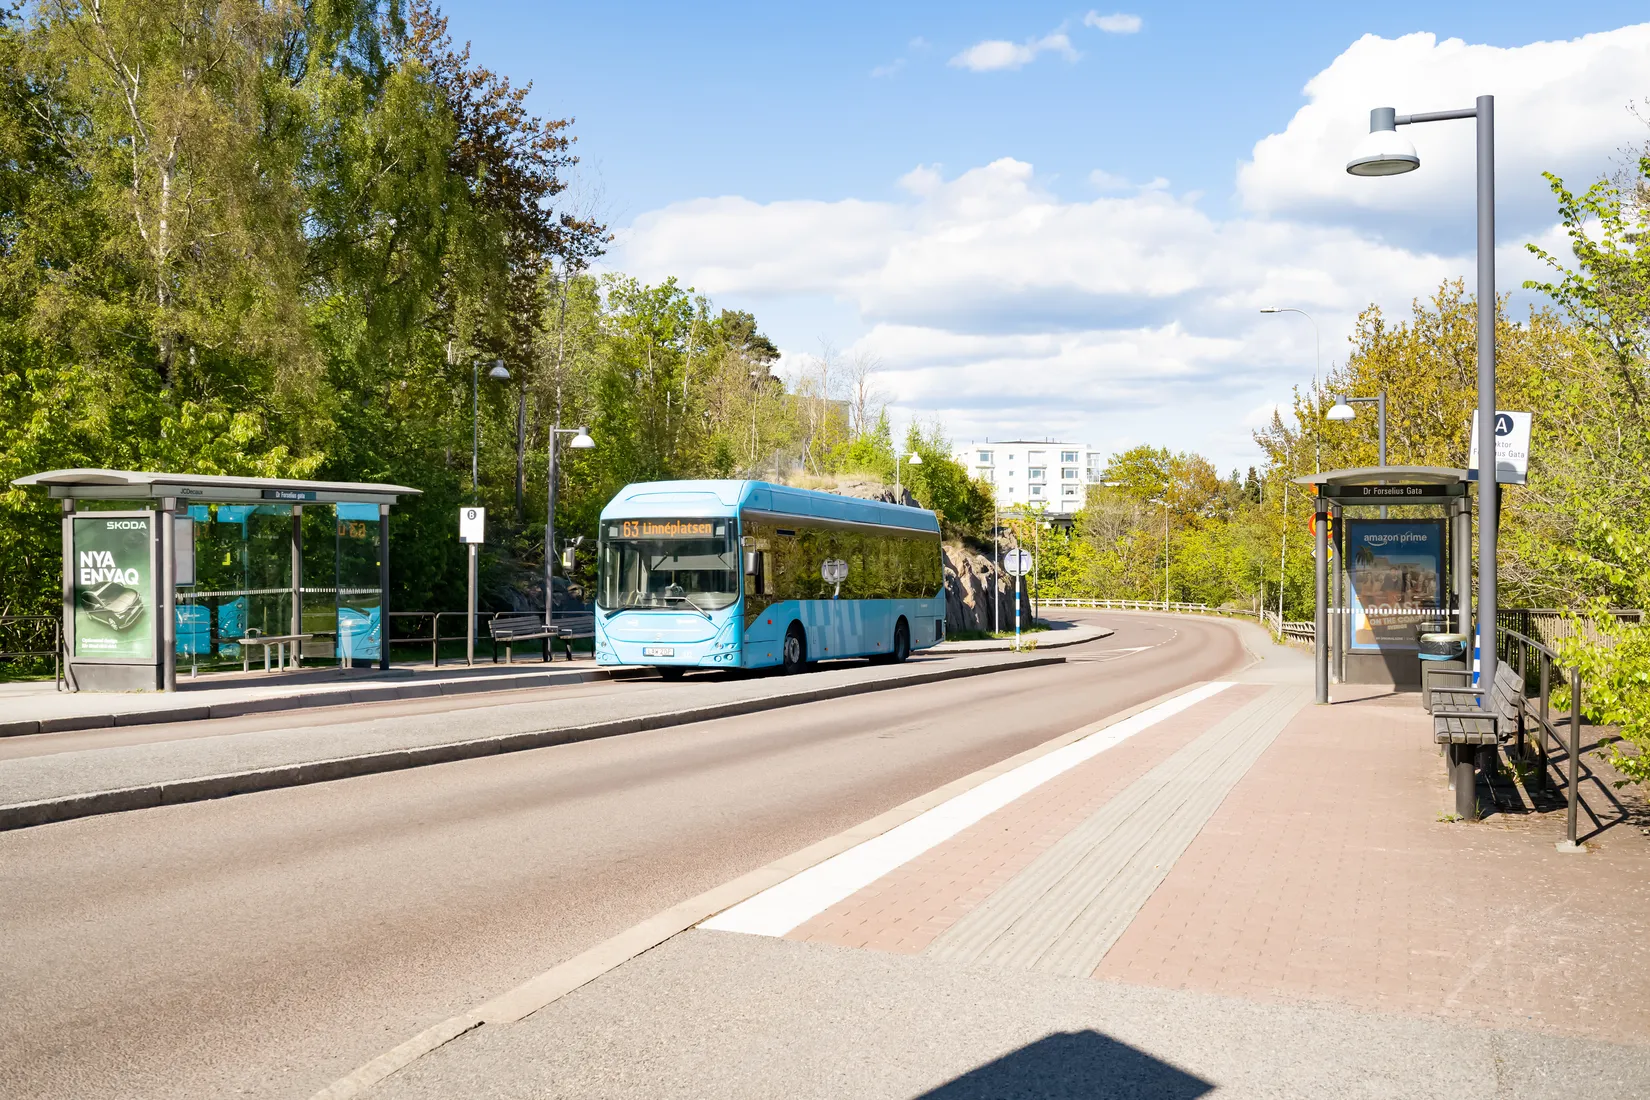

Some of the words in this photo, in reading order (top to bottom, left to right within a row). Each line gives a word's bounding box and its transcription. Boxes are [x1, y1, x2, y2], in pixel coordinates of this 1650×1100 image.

[1495, 417, 1508, 433] A
[1508, 450, 1525, 458] Gata
[1363, 487, 1372, 495] Dr
[1373, 487, 1404, 495] Forselius
[1406, 487, 1423, 495] Gata
[623, 521, 639, 538] 63
[643, 520, 712, 537] Linnéplatsen
[1363, 534, 1399, 542] amazon
[1400, 532, 1428, 544] prime
[80, 551, 116, 568] NYA
[80, 568, 139, 586] ENYAQ
[1368, 601, 1421, 618] ROAST
[1370, 618, 1382, 626] ON
[1383, 617, 1396, 625] THE
